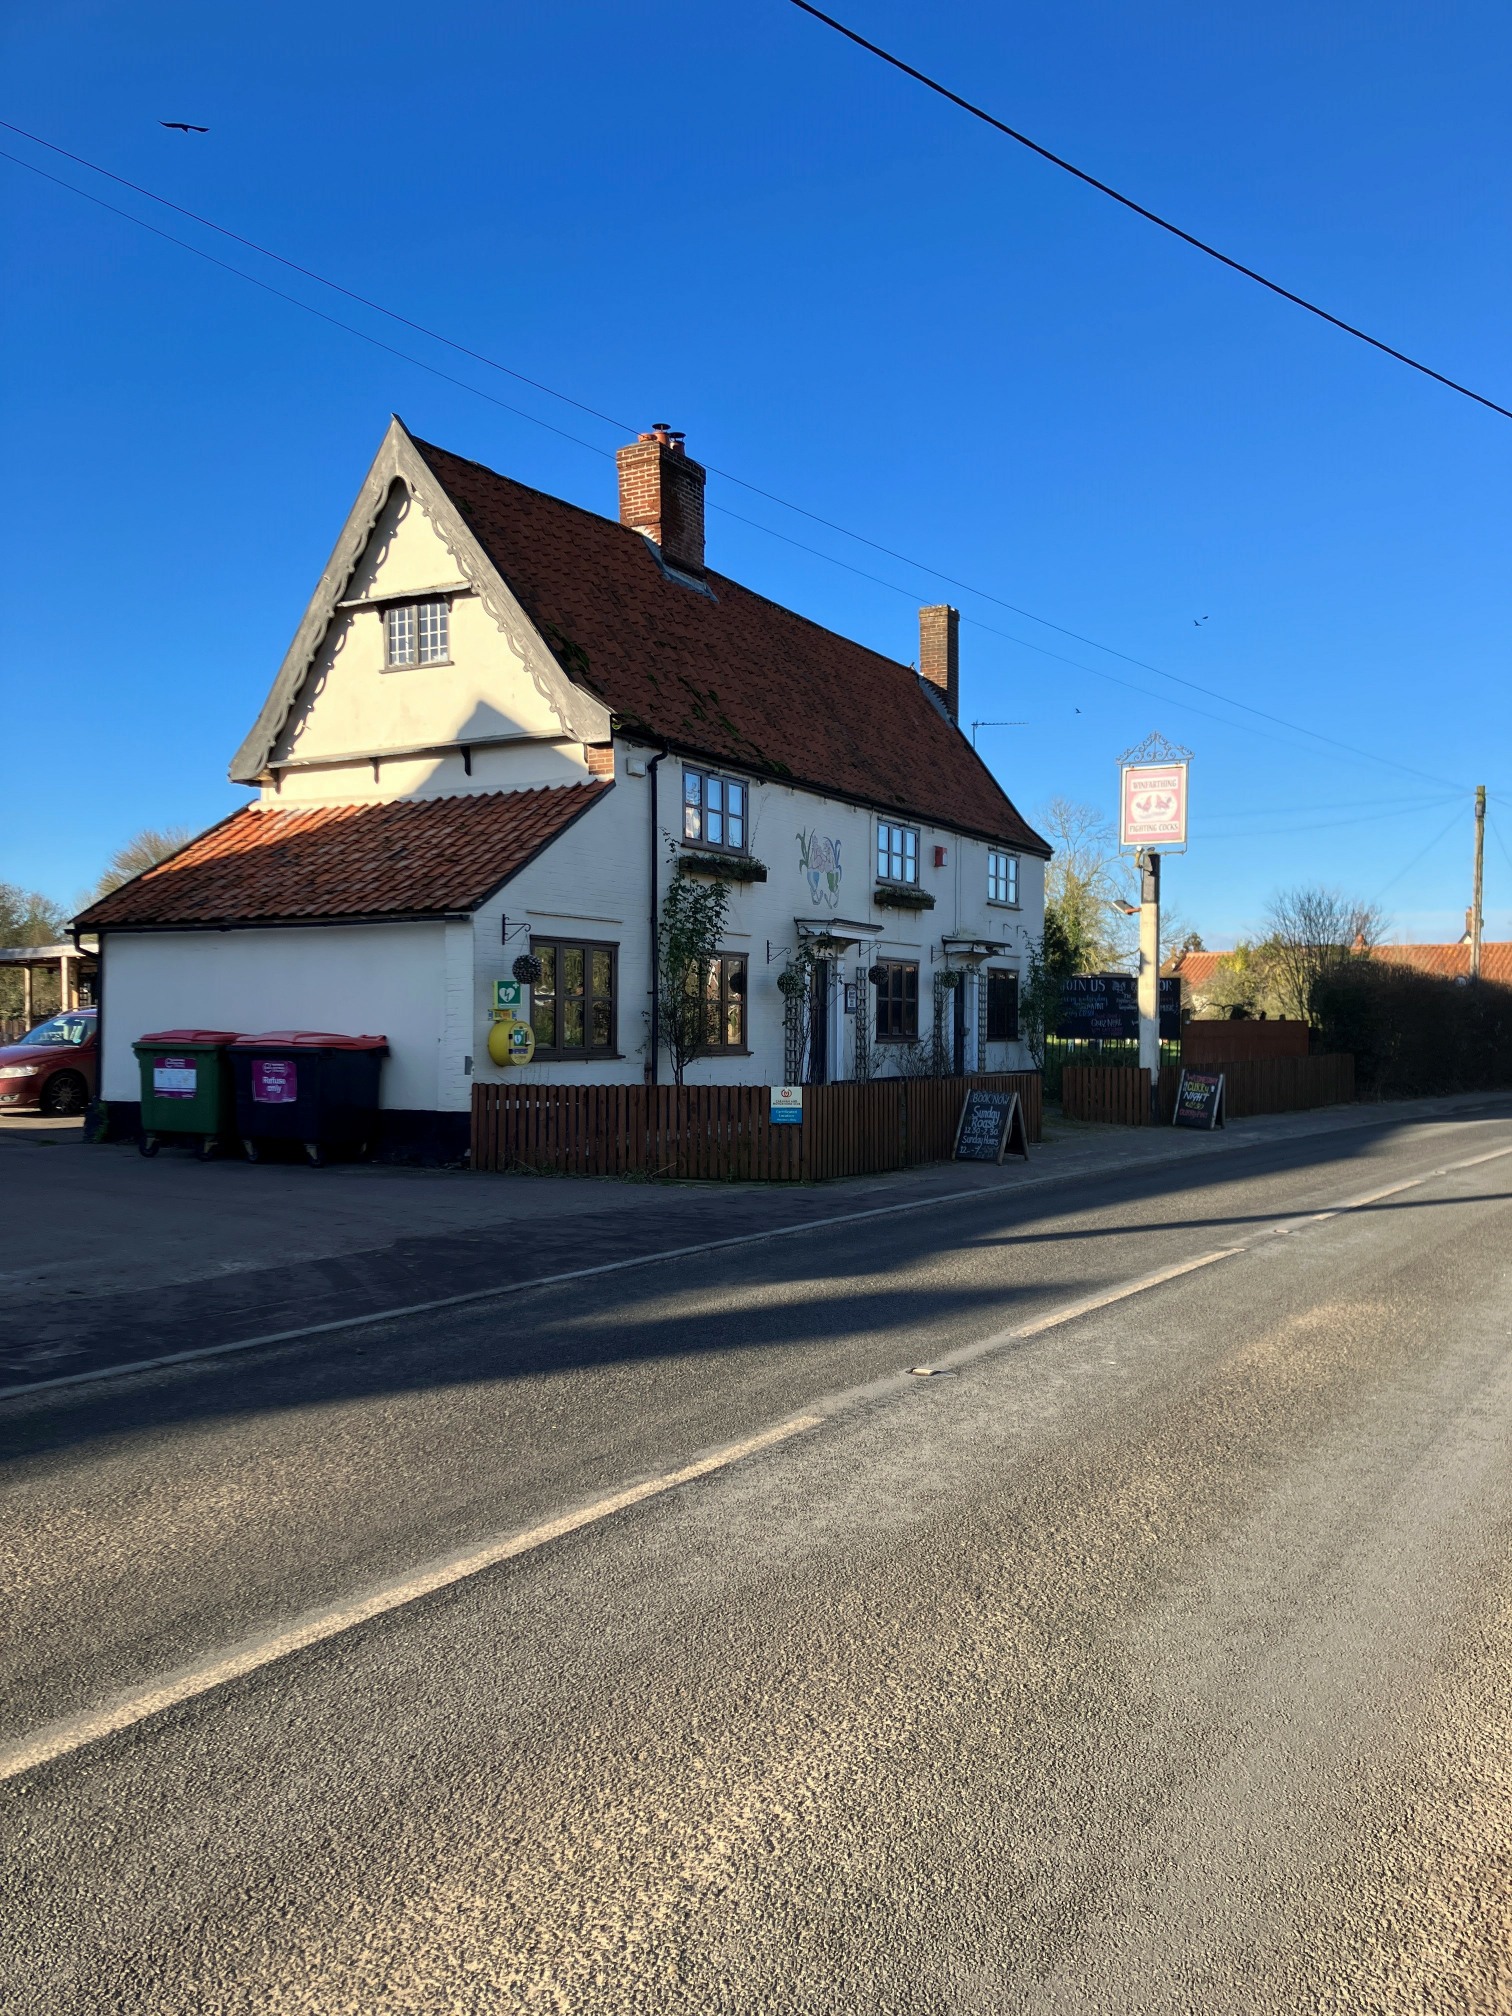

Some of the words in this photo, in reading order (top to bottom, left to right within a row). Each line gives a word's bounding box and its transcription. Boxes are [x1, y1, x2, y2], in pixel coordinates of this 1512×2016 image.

[1133, 779, 1177, 790] WINFARTHING
[1129, 824, 1157, 833] FIGHTING
[1158, 823, 1178, 832] COCKS
[1090, 979, 1106, 992] US
[262, 1076, 286, 1084] Refuse
[267, 1085, 282, 1093] only
[972, 1092, 990, 1103] BOOK
[992, 1093, 1009, 1105] NOW
[1183, 1091, 1210, 1102] NIGHT
[973, 1105, 1000, 1125] Sunday
[971, 1114, 995, 1129] Roast
[962, 1134, 982, 1147] Sunday
